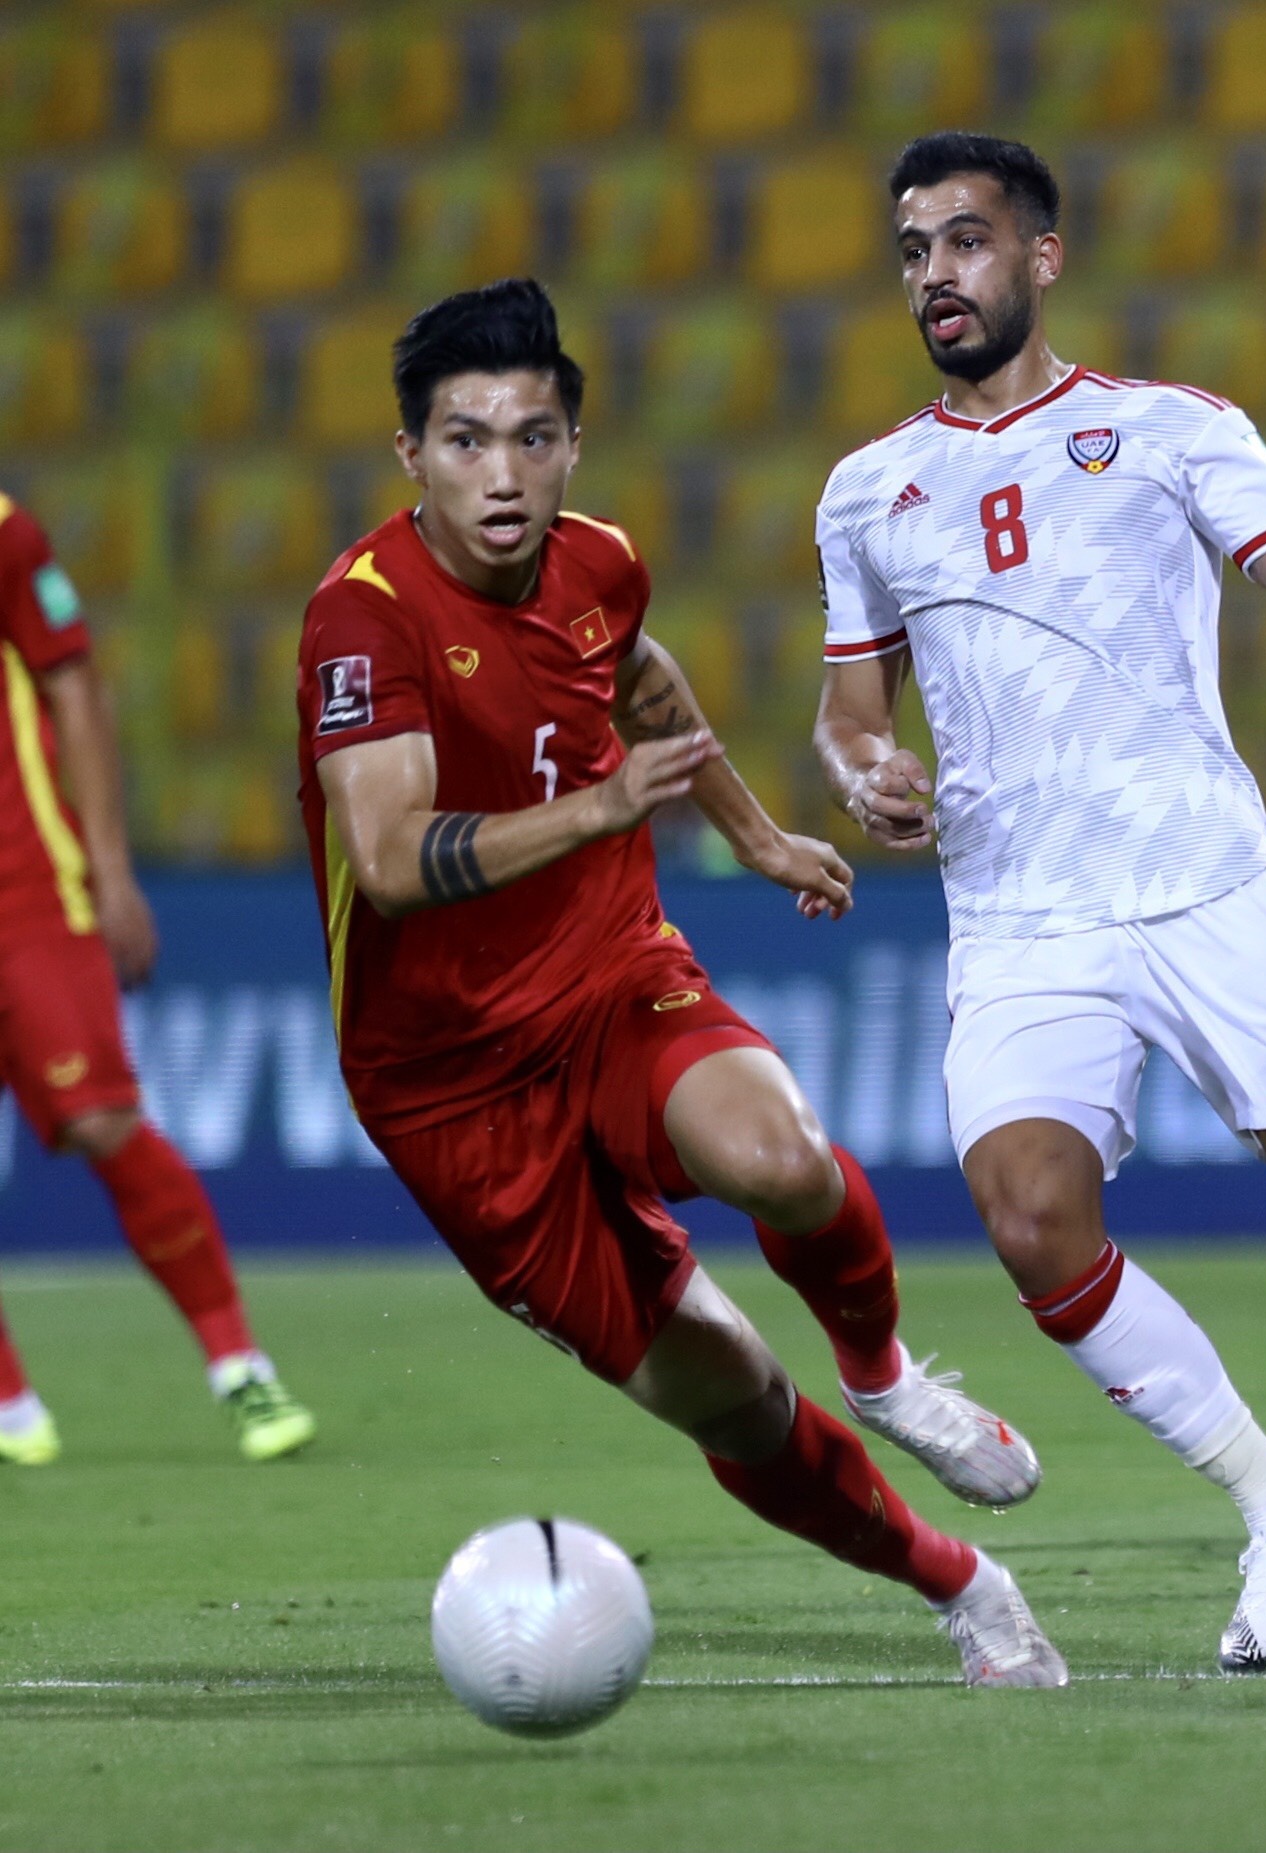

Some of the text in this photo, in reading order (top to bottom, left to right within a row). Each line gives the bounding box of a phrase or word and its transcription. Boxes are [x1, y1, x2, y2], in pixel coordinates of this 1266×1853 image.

[1081, 440, 1105, 448] UAE
[888, 494, 930, 519] adidas
[980, 483, 1028, 574] 8
[532, 722, 558, 804] 5
